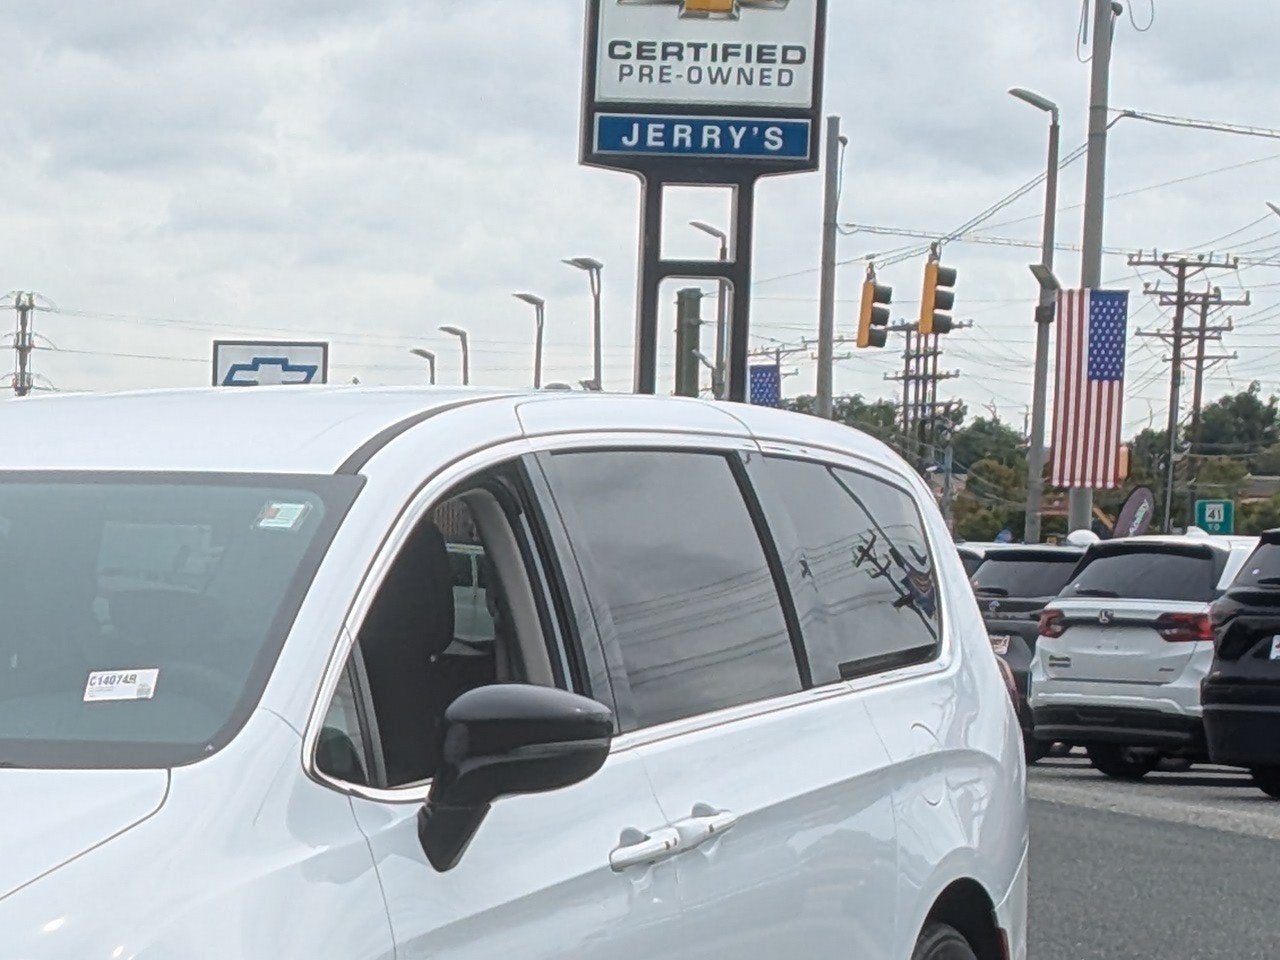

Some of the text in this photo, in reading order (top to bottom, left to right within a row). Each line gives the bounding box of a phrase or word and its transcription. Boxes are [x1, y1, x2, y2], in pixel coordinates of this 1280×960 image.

[607, 40, 807, 65] CERTIFIED
[618, 64, 794, 87] PRE-OWNED
[621, 122, 784, 151] JERRY'S
[1207, 510, 1222, 520] 41
